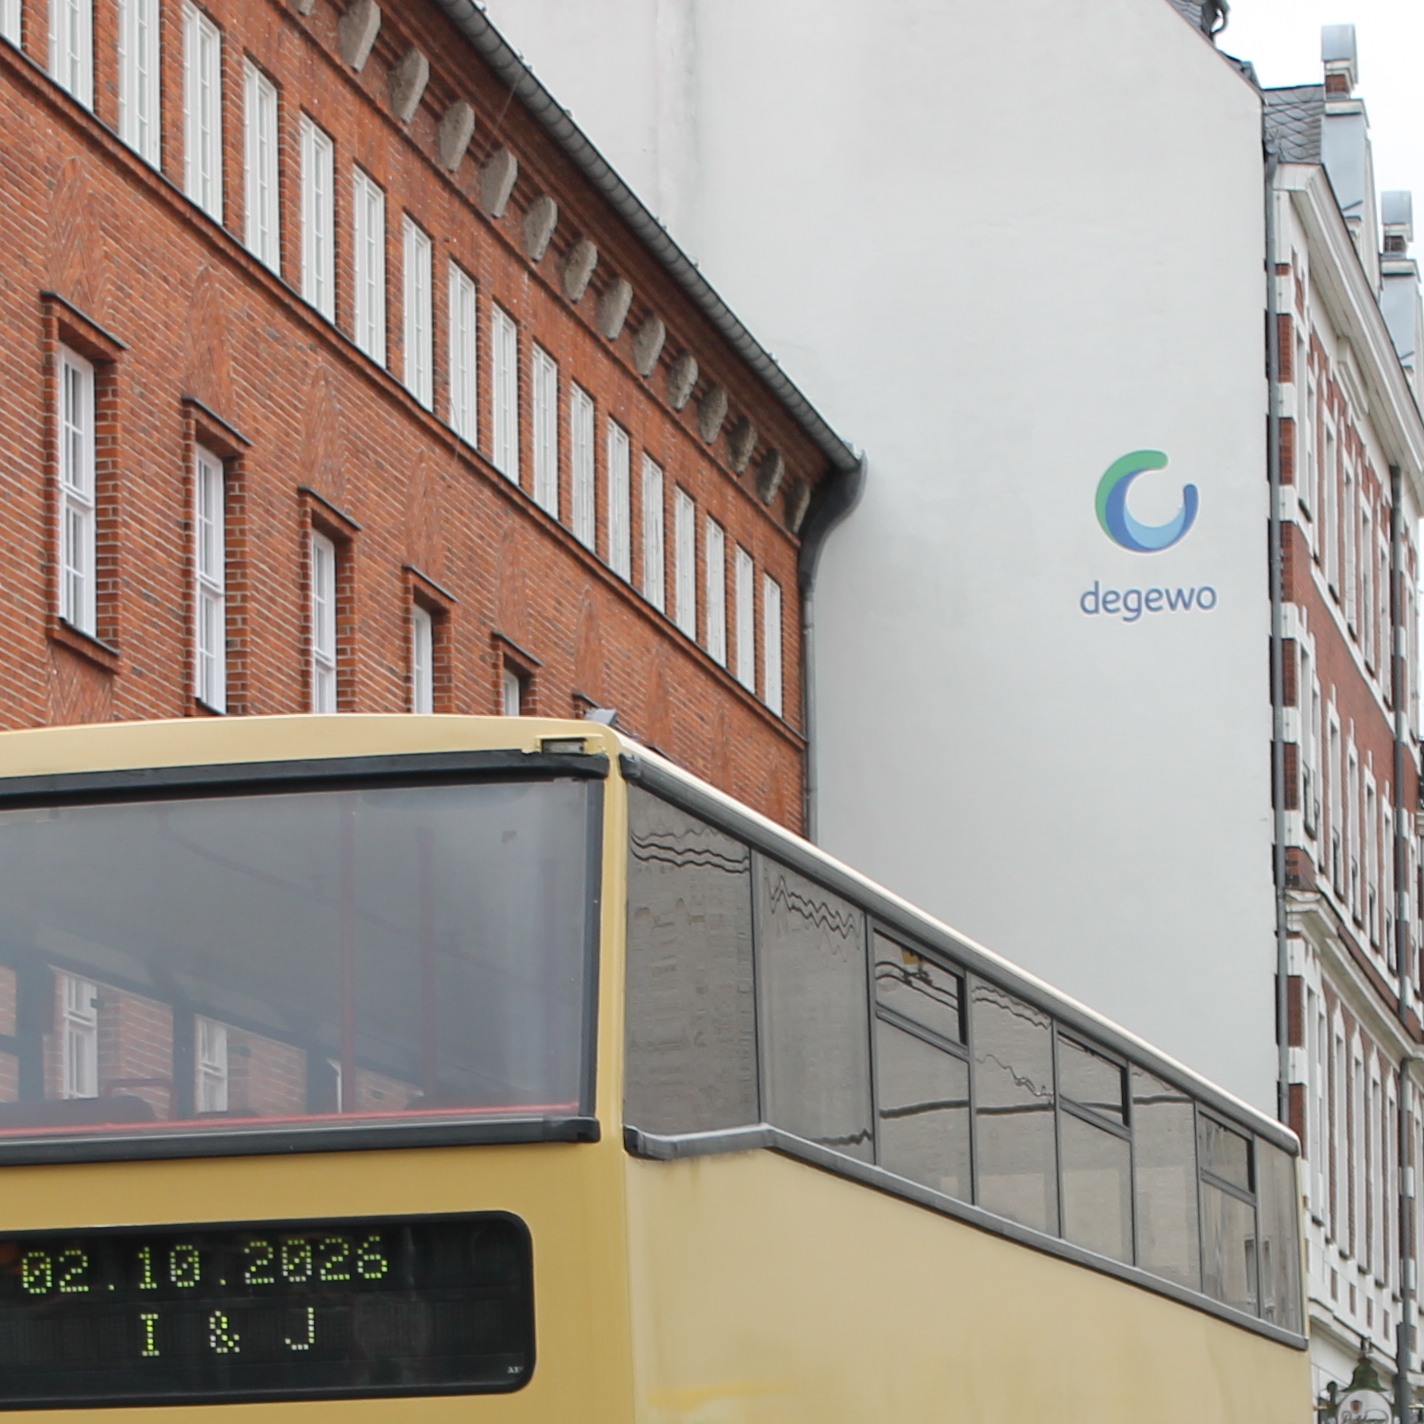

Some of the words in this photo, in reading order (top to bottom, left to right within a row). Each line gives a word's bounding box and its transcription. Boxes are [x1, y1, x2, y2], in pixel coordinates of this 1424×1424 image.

[1080, 580, 1217, 623] degewo
[22, 1236, 387, 1294] 02.10.2026
[140, 1313, 160, 1356] I
[209, 1310, 240, 1354] &
[285, 1306, 315, 1351] J
